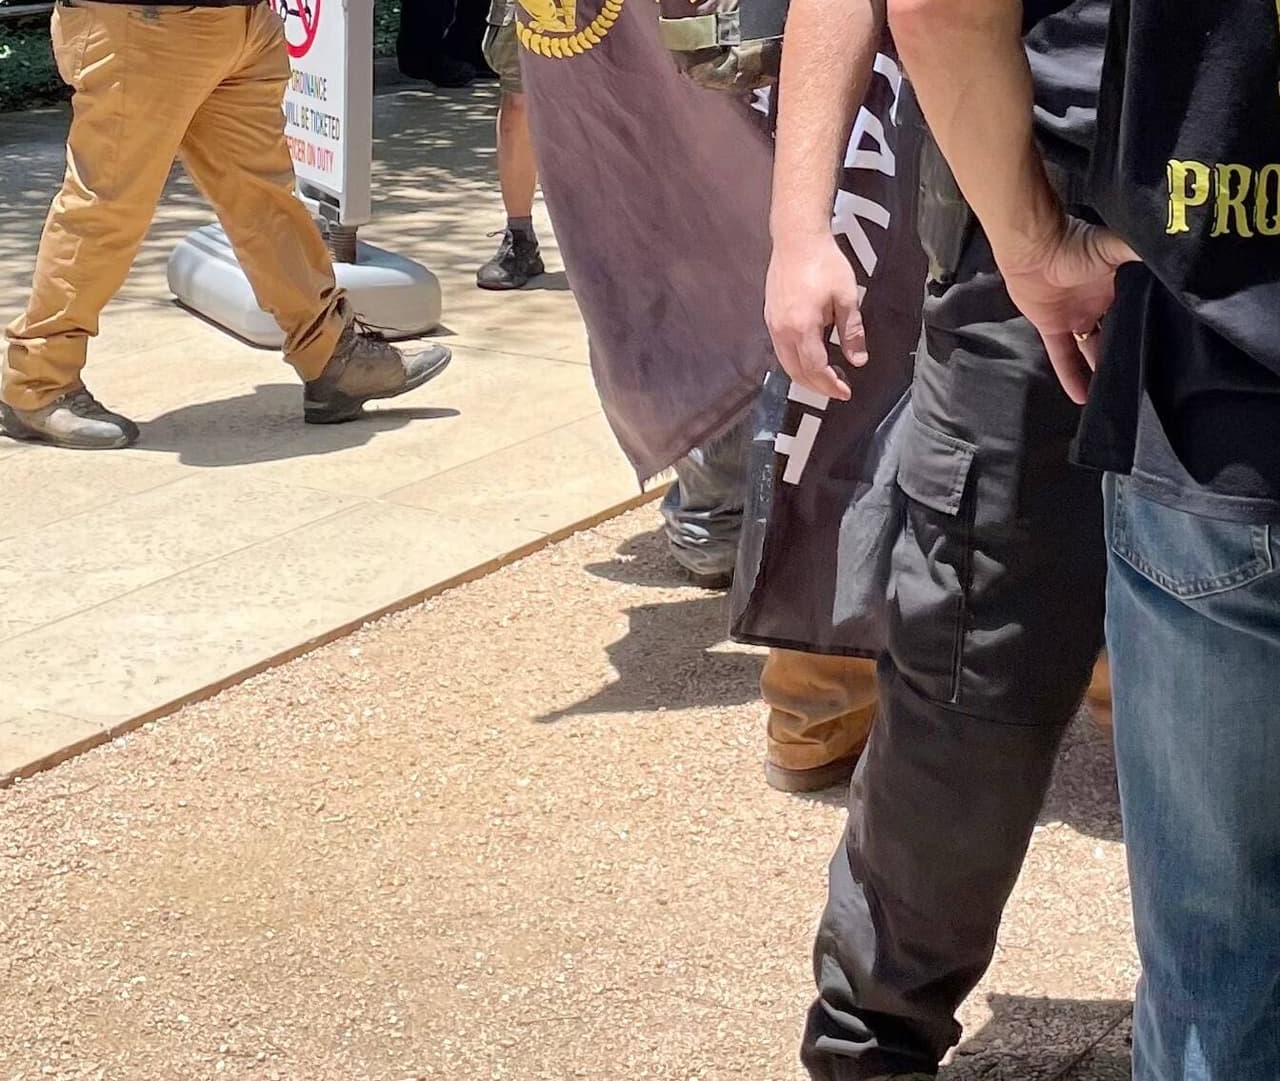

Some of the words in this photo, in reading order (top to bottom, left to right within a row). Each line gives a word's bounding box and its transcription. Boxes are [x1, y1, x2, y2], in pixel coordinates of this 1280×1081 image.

[301, 106, 309, 130] BE
[310, 109, 340, 140] TICKETED
[317, 147, 335, 173] DUTY
